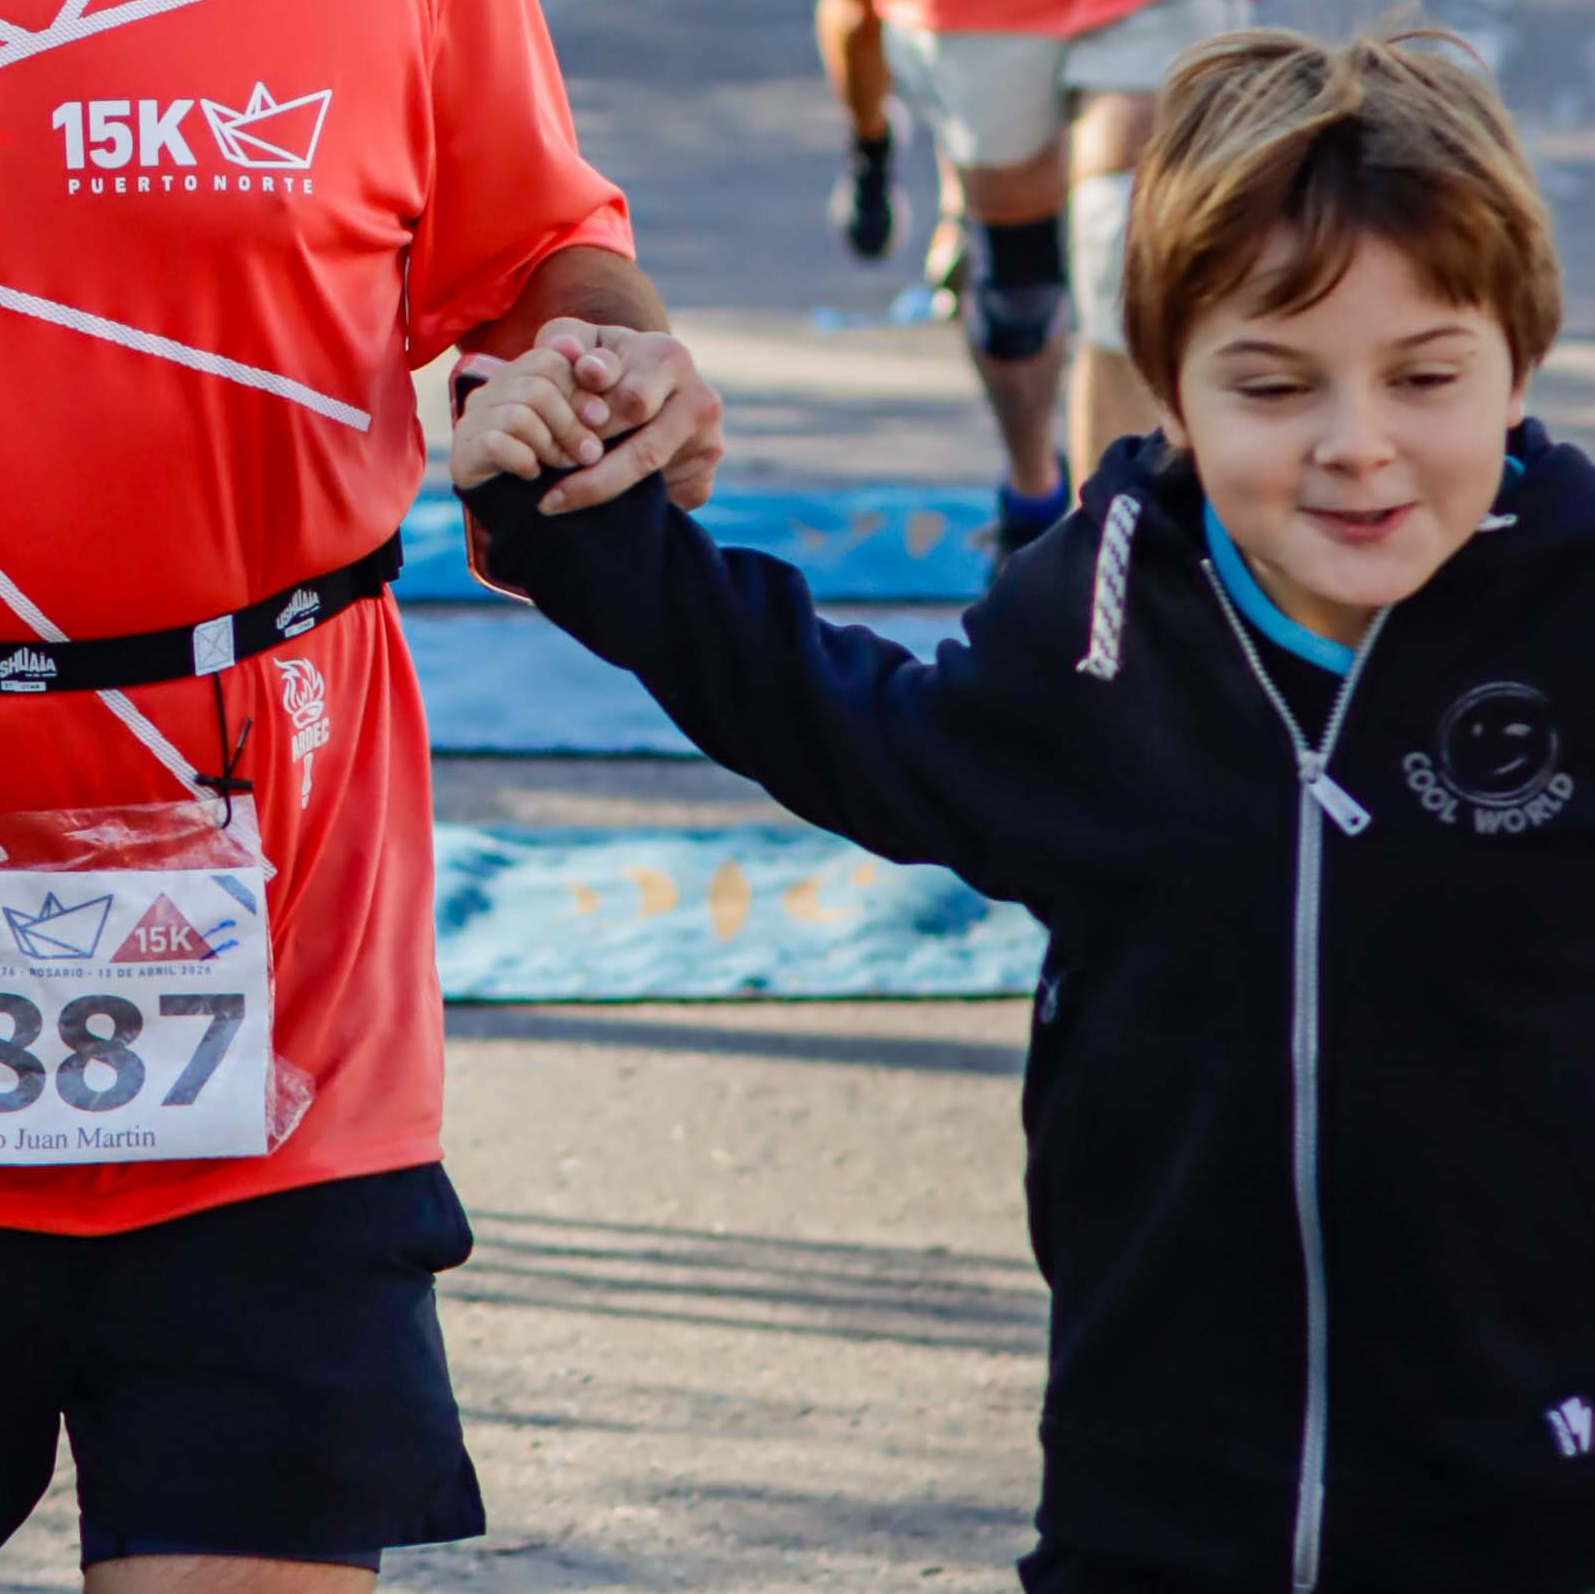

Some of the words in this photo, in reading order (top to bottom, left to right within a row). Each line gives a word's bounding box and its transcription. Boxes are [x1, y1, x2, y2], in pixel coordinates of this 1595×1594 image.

[52, 99, 204, 170] 15K
[68, 176, 197, 195] PUERTO
[214, 175, 314, 195] NORTE
[1403, 752, 1459, 823] COOL
[1474, 772, 1574, 833] WORLD
[134, 925, 193, 955] 15K
[29, 966, 84, 978] ROSARIO
[117, 967, 133, 978] DE
[138, 966, 176, 978] ABRIL
[14, 1127, 69, 1150] Juan
[77, 1125, 157, 1149] Martin
